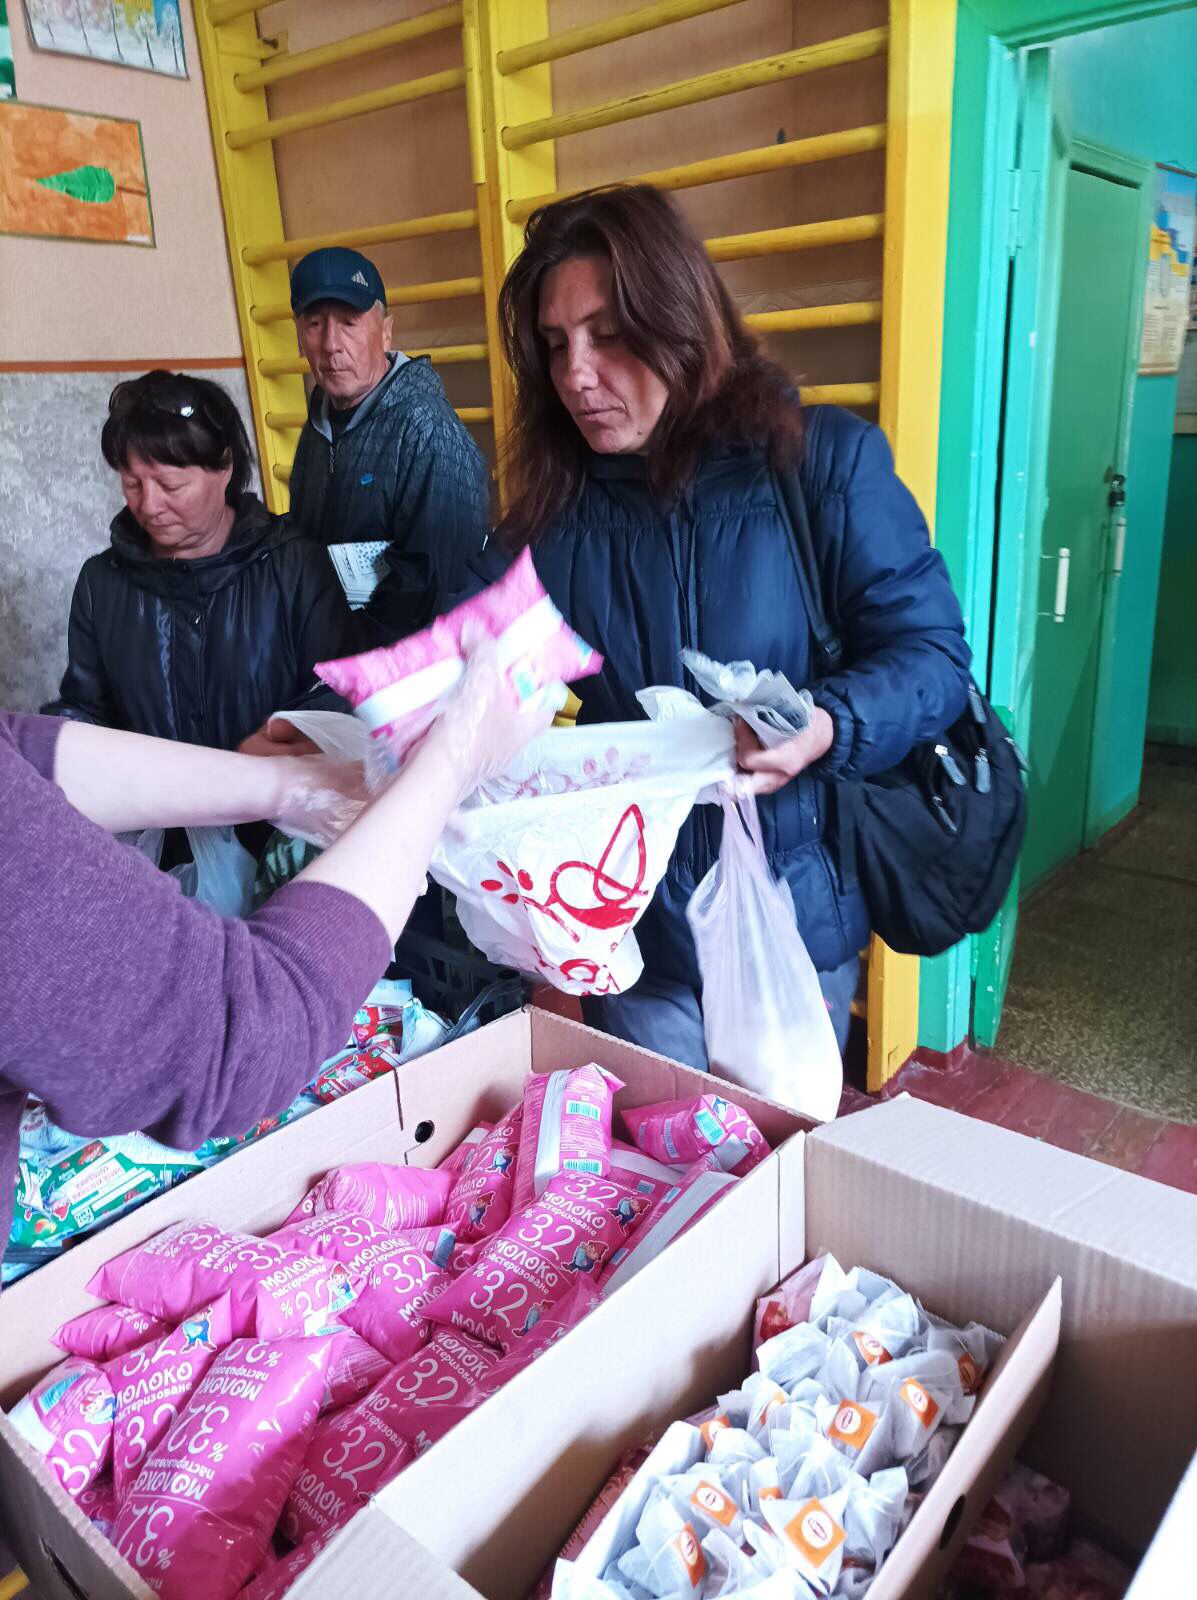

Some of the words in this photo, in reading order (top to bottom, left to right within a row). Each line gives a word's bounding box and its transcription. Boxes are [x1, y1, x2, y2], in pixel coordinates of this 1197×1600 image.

[564, 1178, 618, 1208] 3,2
[332, 1217, 389, 1247] 3,2
[518, 1213, 576, 1260] 3,2
[236, 1242, 298, 1270] 3,2
[383, 1253, 440, 1293] 3,2
[486, 1251, 550, 1295] астеризоване
[470, 1270, 528, 1328] 3,2
[436, 1331, 489, 1378] МОЛОК
[395, 1358, 459, 1406] 3,2
[166, 1400, 230, 1455] 3,2
[51, 1428, 112, 1495] 3,2
[322, 1425, 386, 1491] 3,2
[114, 1500, 175, 1568] 3,2
